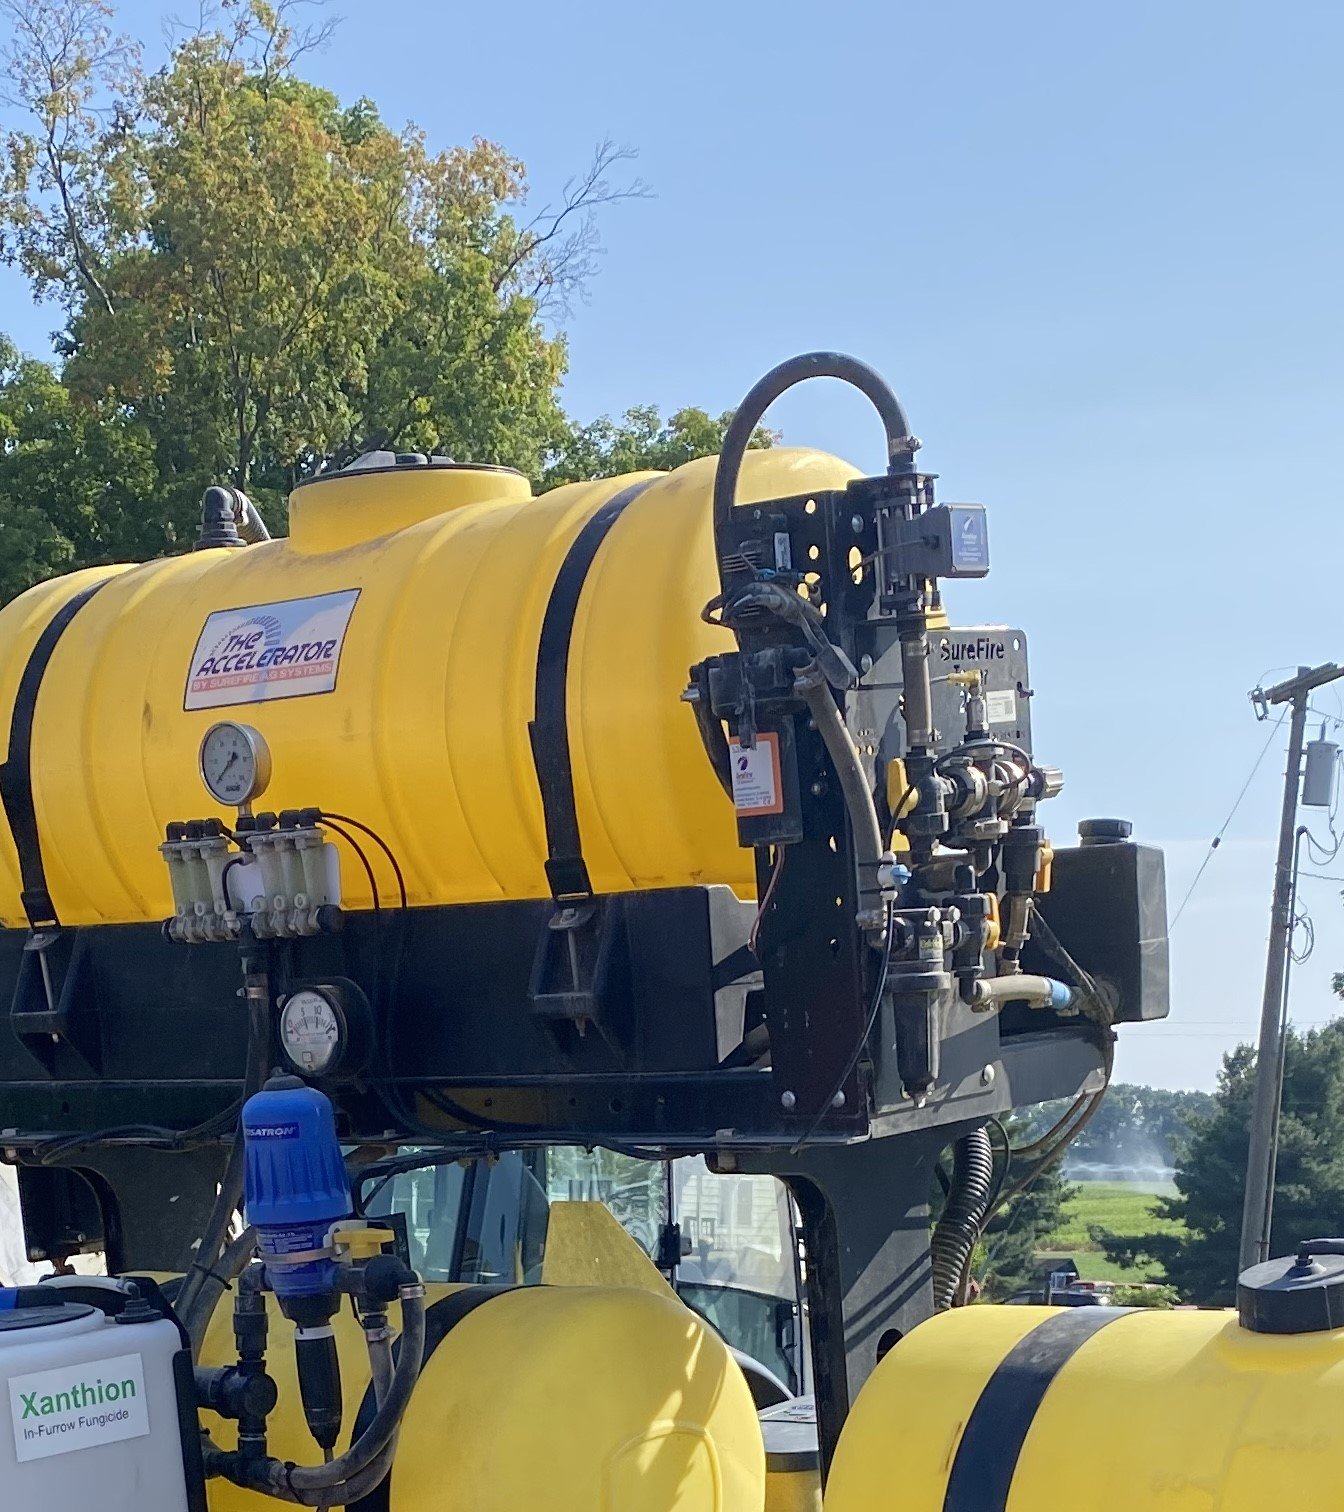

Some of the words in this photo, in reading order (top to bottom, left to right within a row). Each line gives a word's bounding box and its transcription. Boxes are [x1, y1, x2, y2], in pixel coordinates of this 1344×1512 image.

[222, 630, 265, 653] THE
[939, 637, 1005, 661] SureFire
[195, 639, 338, 677] ACCELERATOR
[192, 679, 209, 691] BY
[279, 663, 333, 679] SYSTEMS
[19, 1378, 136, 1420] Xanthion
[23, 1420, 76, 1441] In-Furrow
[78, 1409, 130, 1428] Fungicide
